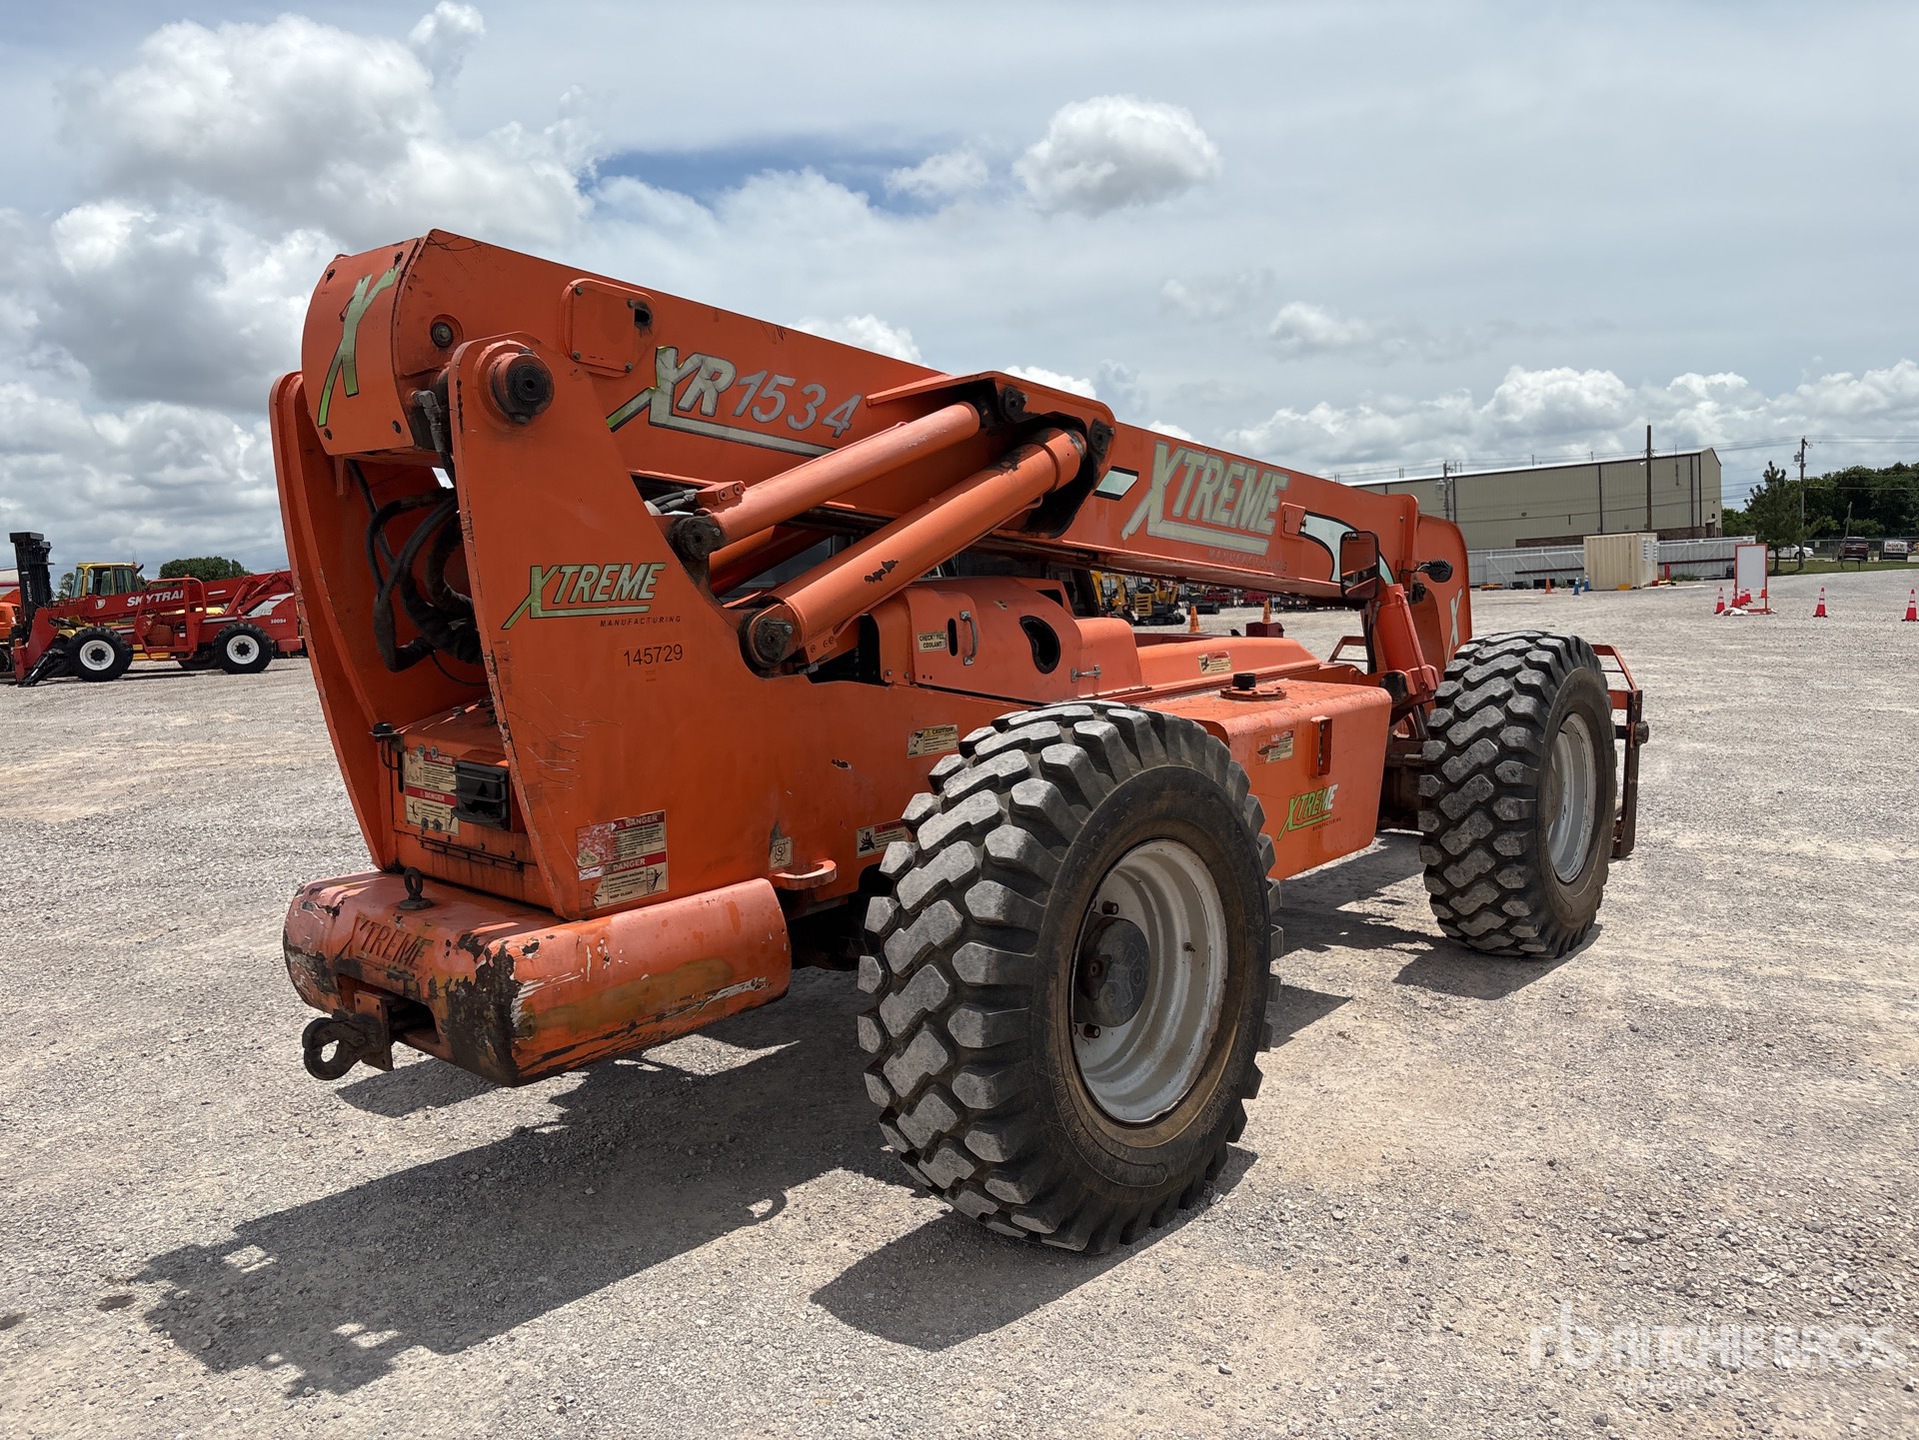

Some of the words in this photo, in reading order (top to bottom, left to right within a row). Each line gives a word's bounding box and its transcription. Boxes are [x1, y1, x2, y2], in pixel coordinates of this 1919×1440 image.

[1121, 440, 1290, 541] XTREME
[501, 562, 666, 630] XTREME
[600, 615, 682, 627] MANUFACTURING
[623, 643, 684, 667] 145729
[625, 815, 658, 827] DANGER
[1277, 784, 1338, 841] XTREME
[613, 858, 646, 871] DANGER
[335, 912, 434, 970] XTREME
